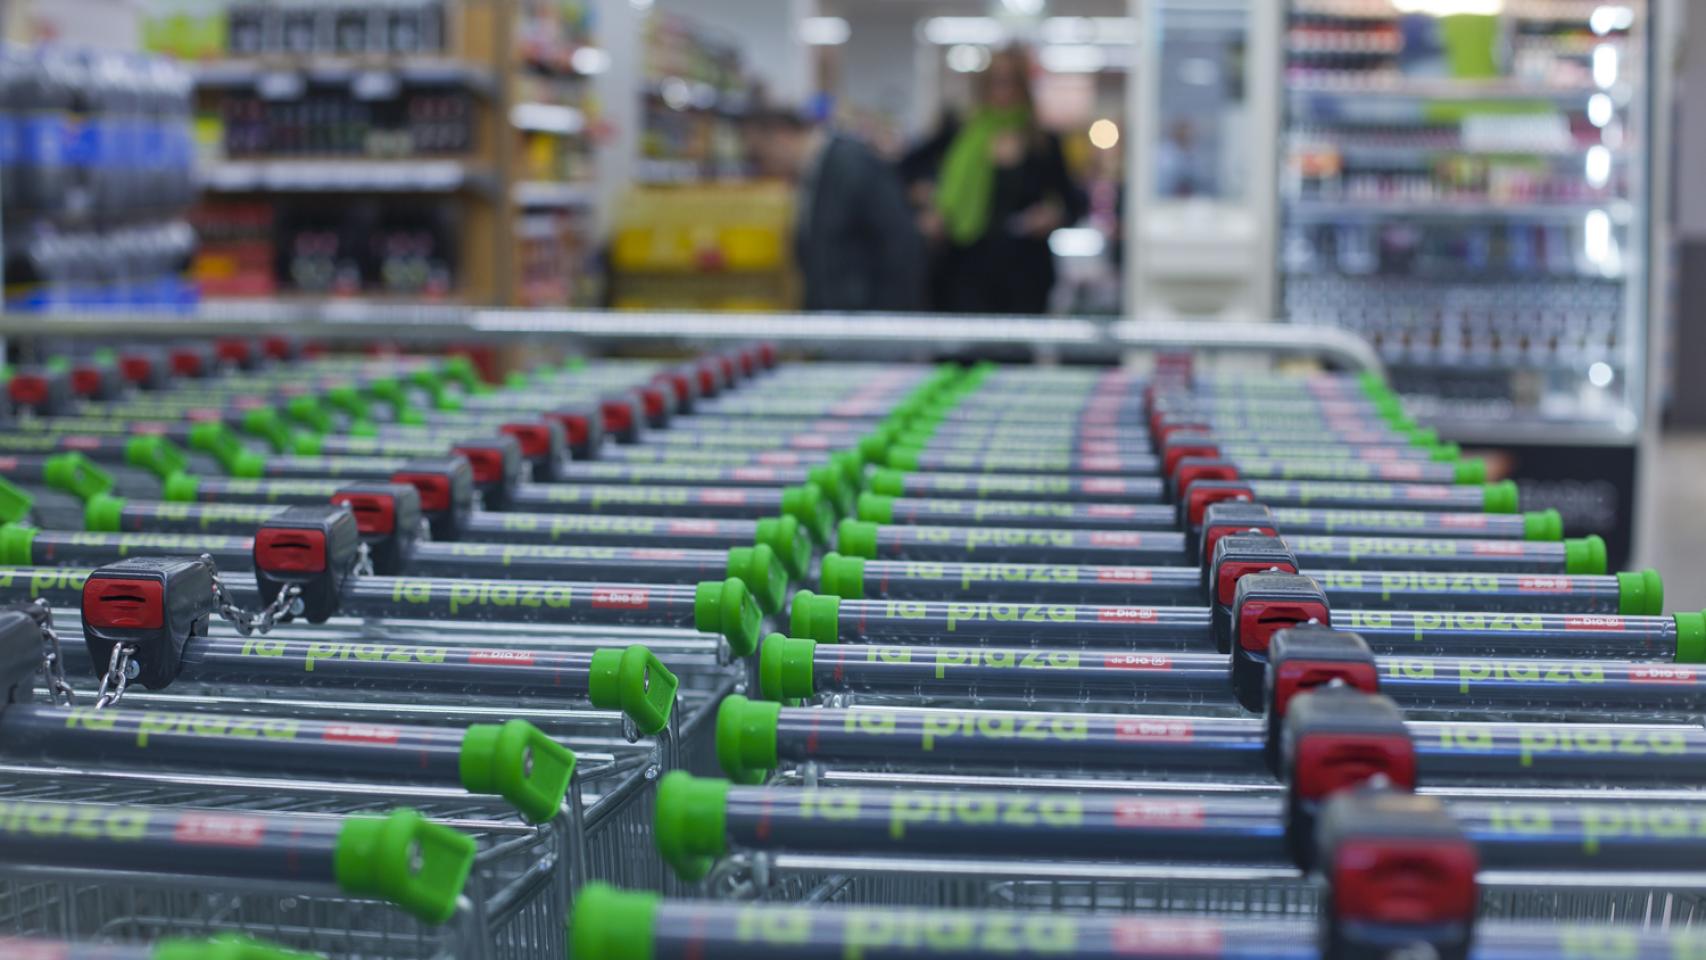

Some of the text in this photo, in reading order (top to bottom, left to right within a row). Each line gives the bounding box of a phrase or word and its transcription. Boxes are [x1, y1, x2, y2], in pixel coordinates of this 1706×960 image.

[450, 582, 570, 615] plaza
[947, 604, 1076, 632] plaza
[1413, 610, 1543, 641] plaza
[935, 649, 1079, 680] plaza
[1459, 661, 1604, 694] plaza
[922, 712, 1088, 751] plaza
